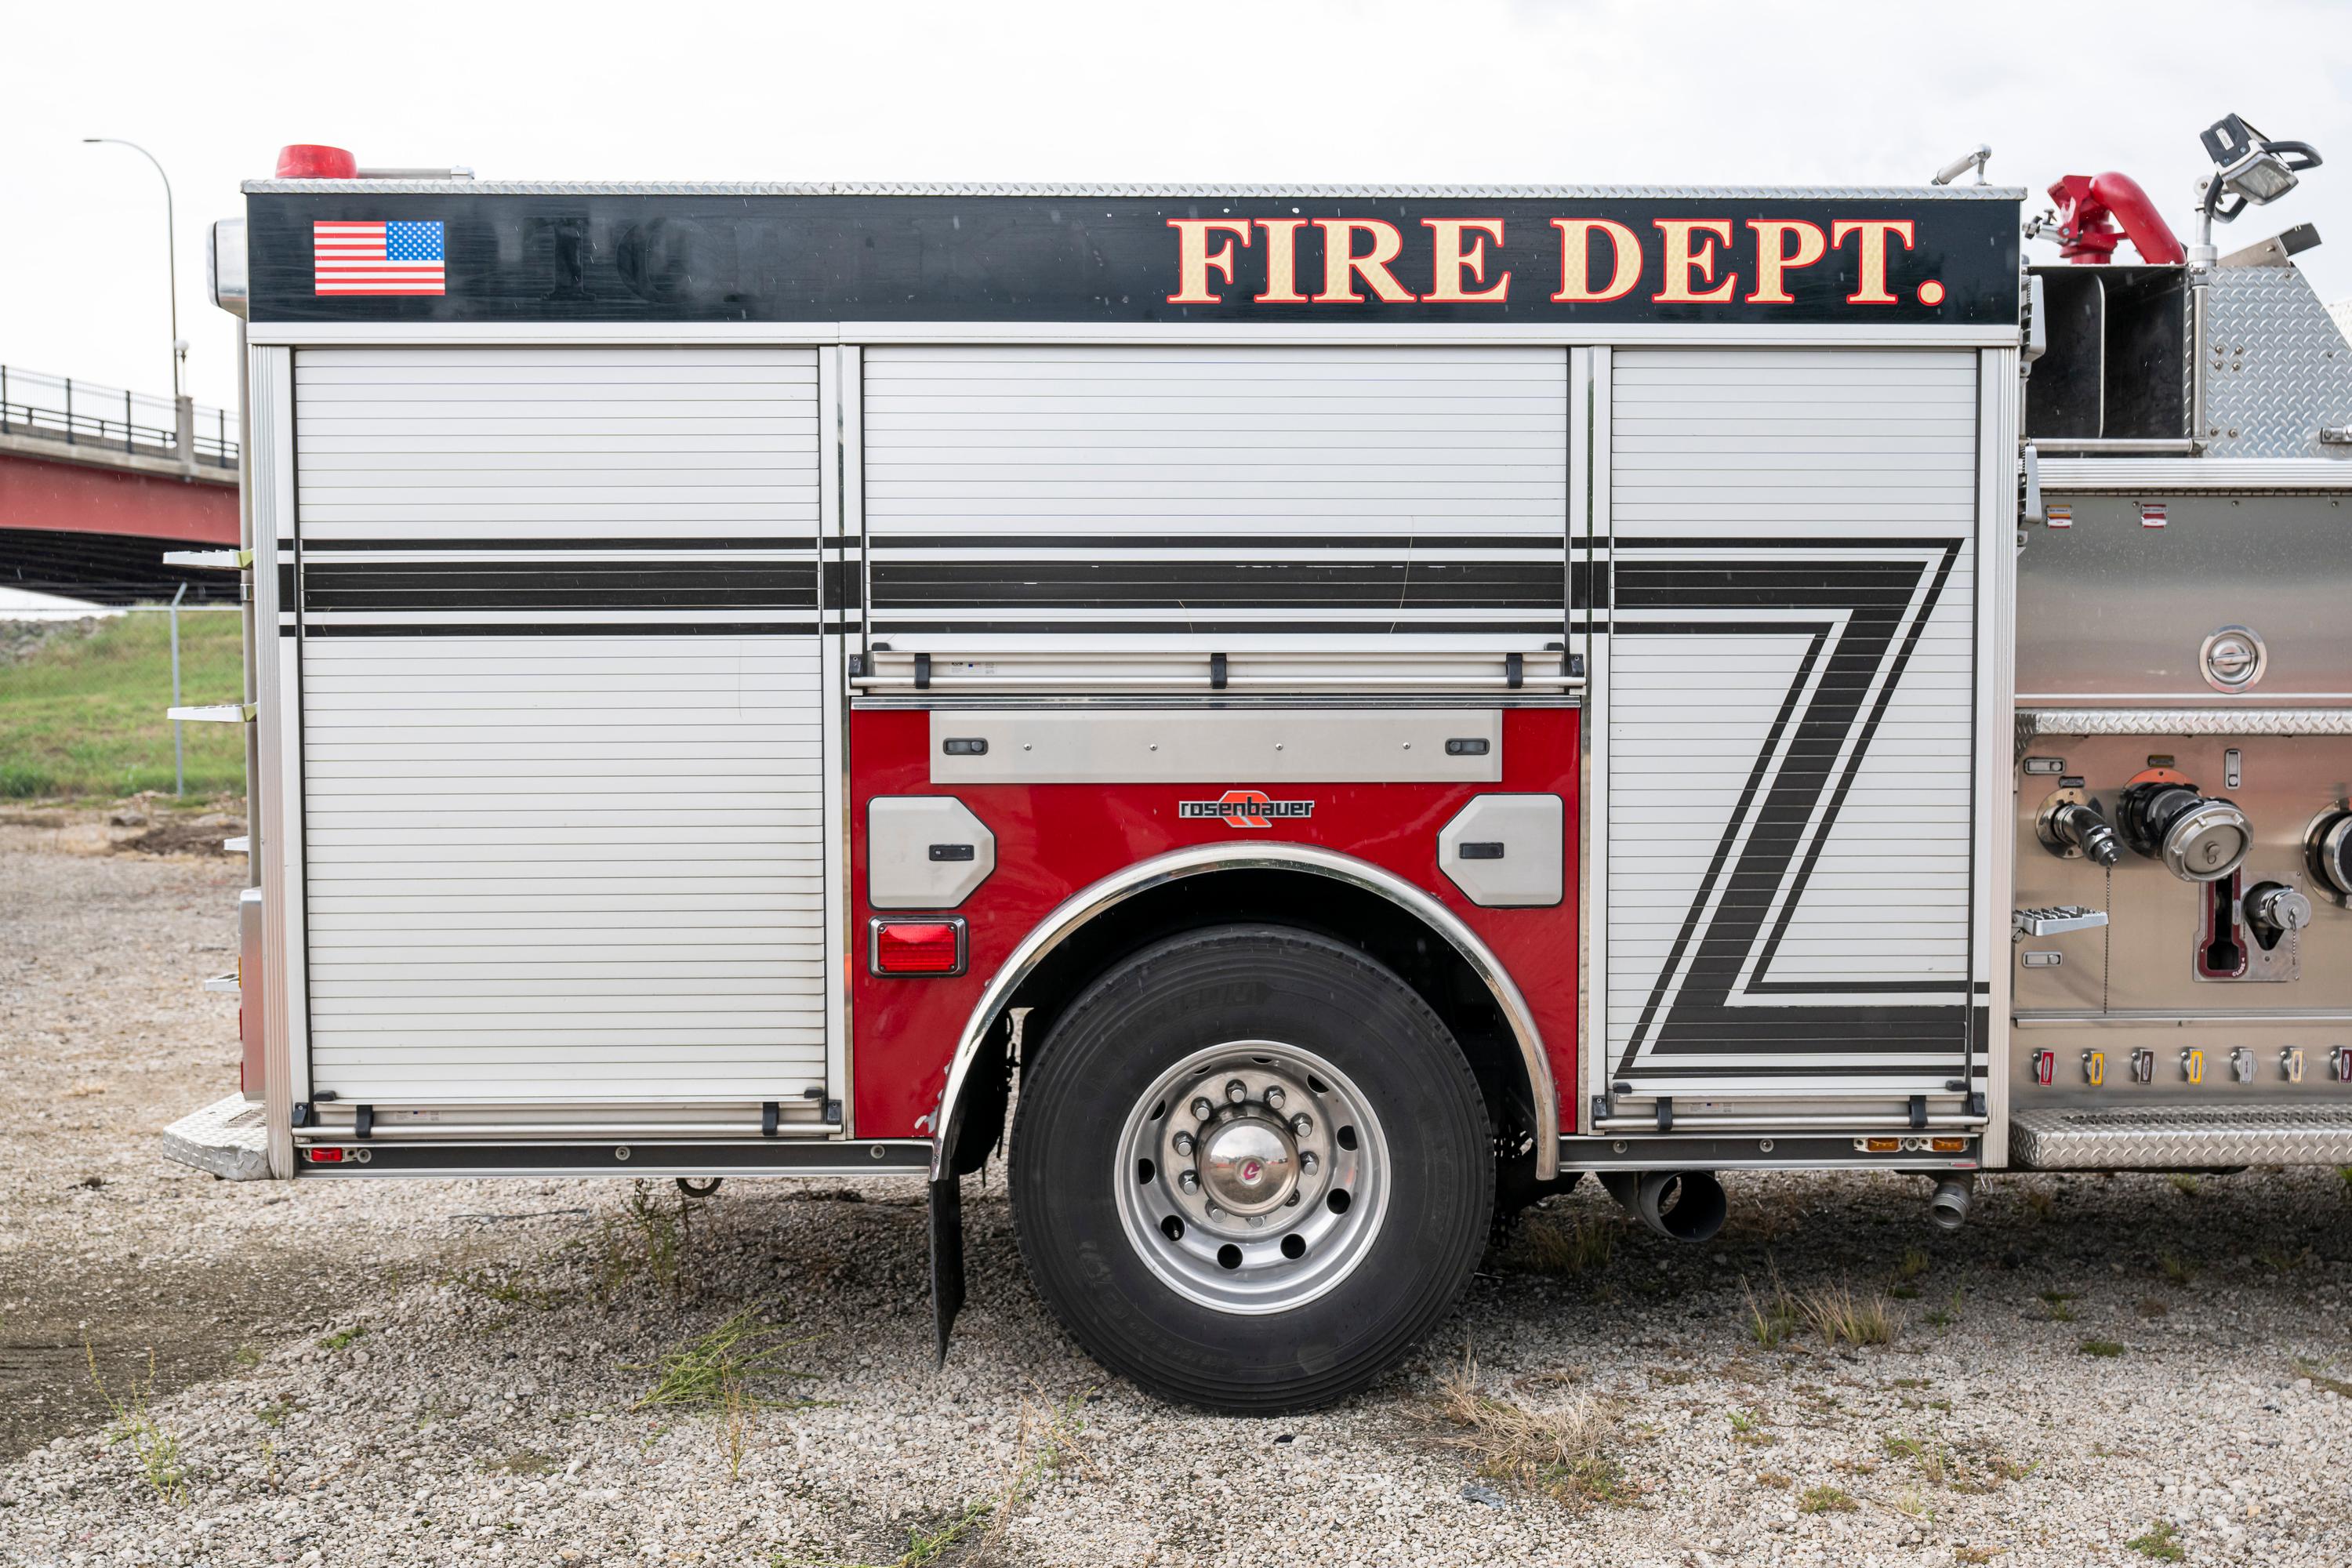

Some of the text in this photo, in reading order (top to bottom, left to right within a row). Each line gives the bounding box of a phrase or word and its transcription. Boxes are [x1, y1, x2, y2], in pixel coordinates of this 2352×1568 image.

[1167, 217, 1511, 304] FIRE
[1550, 217, 1945, 306] DEPT.
[1179, 795, 1315, 817] rosenbauer
